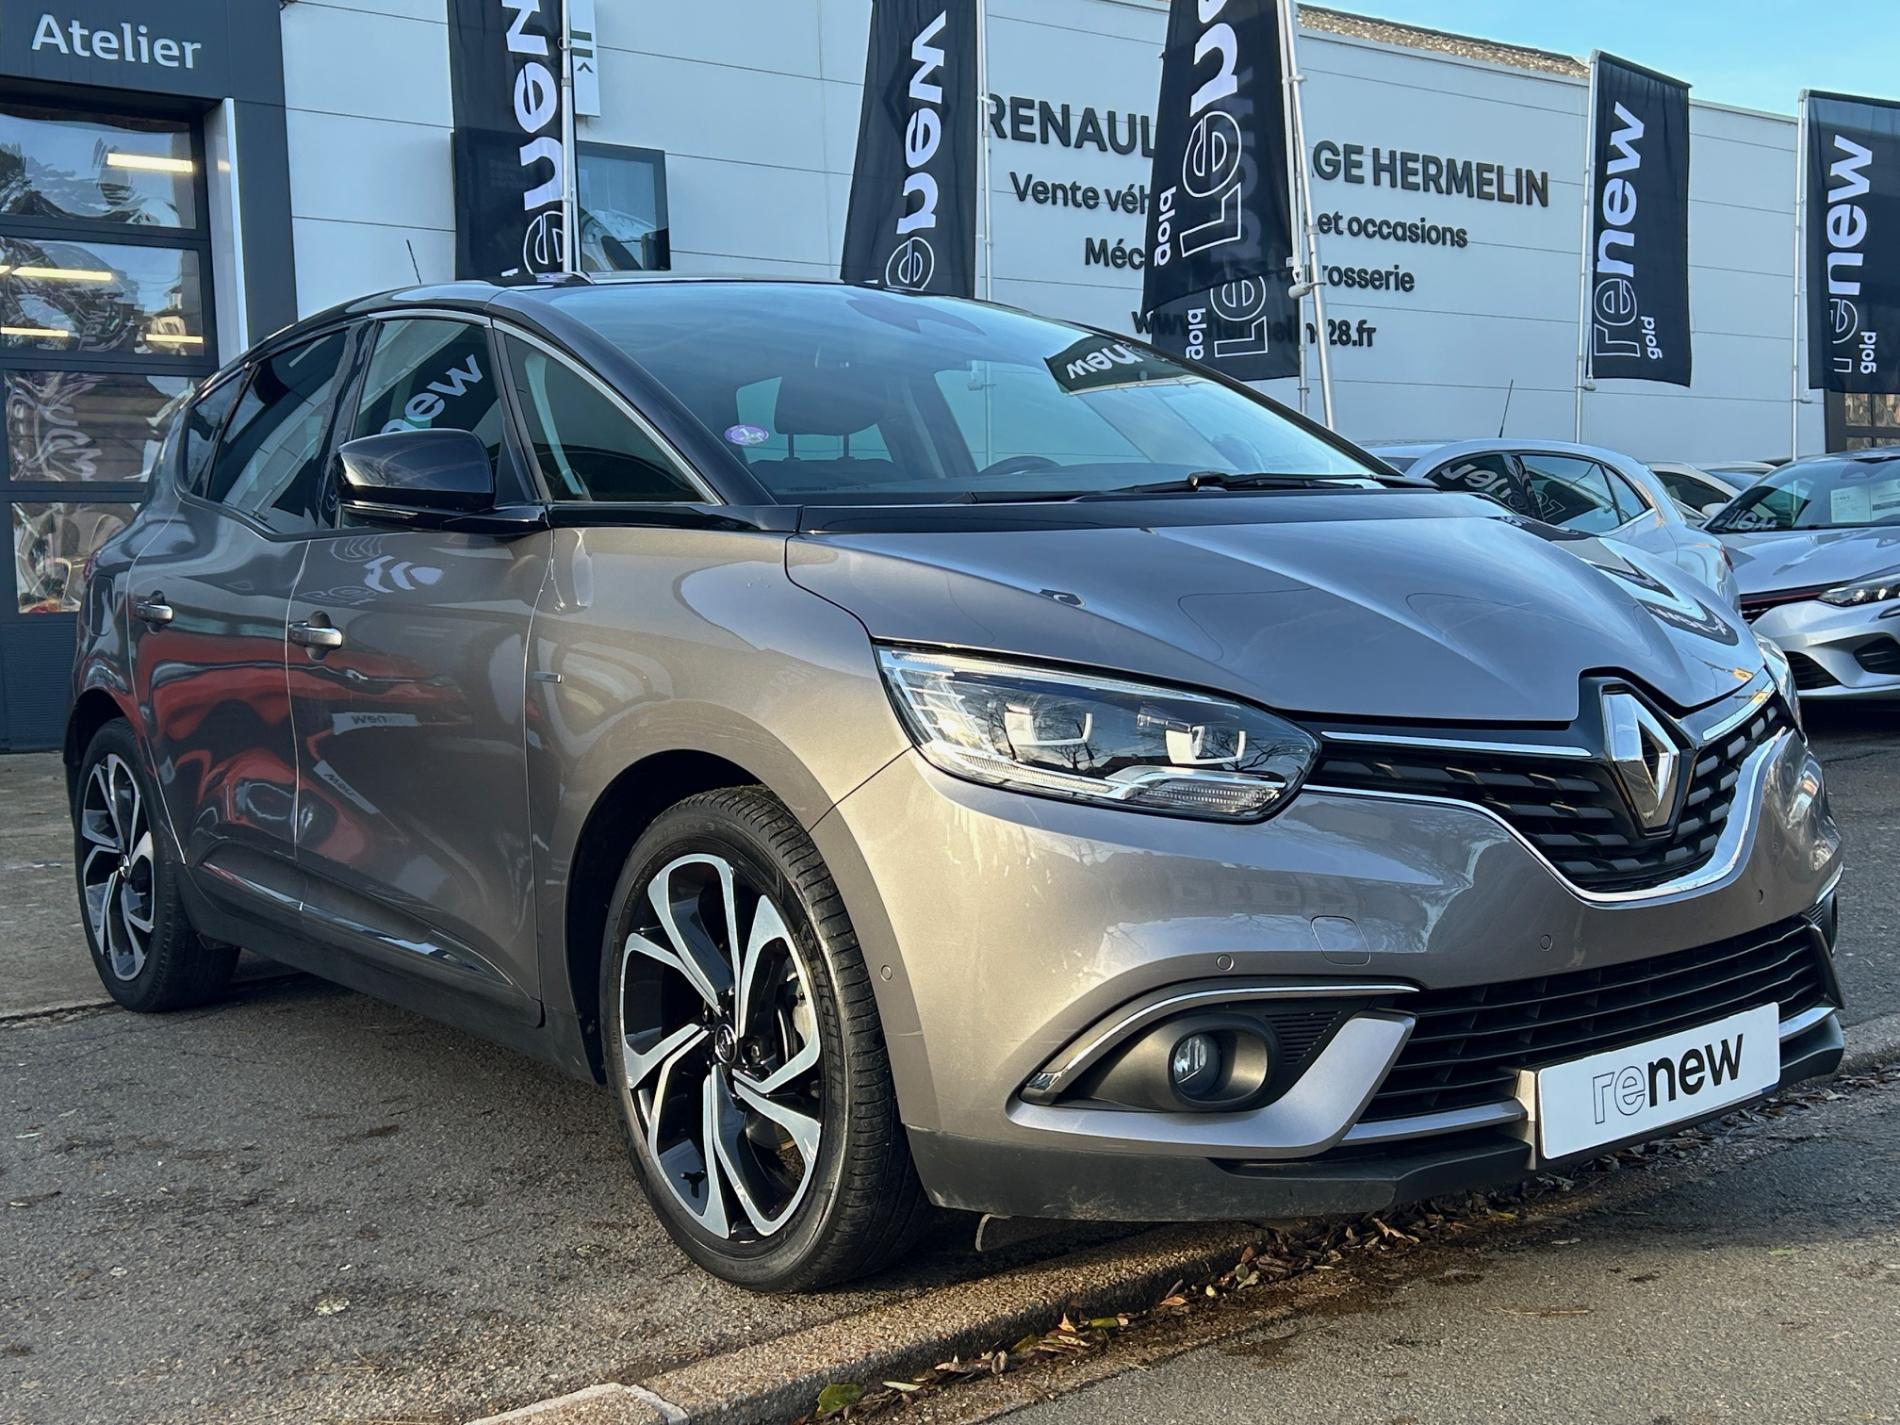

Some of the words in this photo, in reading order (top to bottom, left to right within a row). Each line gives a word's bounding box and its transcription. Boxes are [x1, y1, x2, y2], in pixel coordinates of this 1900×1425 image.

[32, 13, 202, 69] Atelier
[988, 93, 1154, 159] RENAUL
[1311, 139, 1365, 184] GE
[1372, 147, 1549, 208] HERMELIN
[1009, 171, 1100, 210] Vente
[1104, 183, 1150, 215] véh
[1317, 211, 1344, 236] et
[1347, 217, 1468, 248] occasions
[1593, 101, 1645, 358] renew
[1084, 237, 1145, 270] Méc
[1065, 344, 1145, 381] new
[1640, 316, 1663, 360] gold
[1858, 331, 1878, 374] gold
[1592, 1033, 1744, 1125] renew
